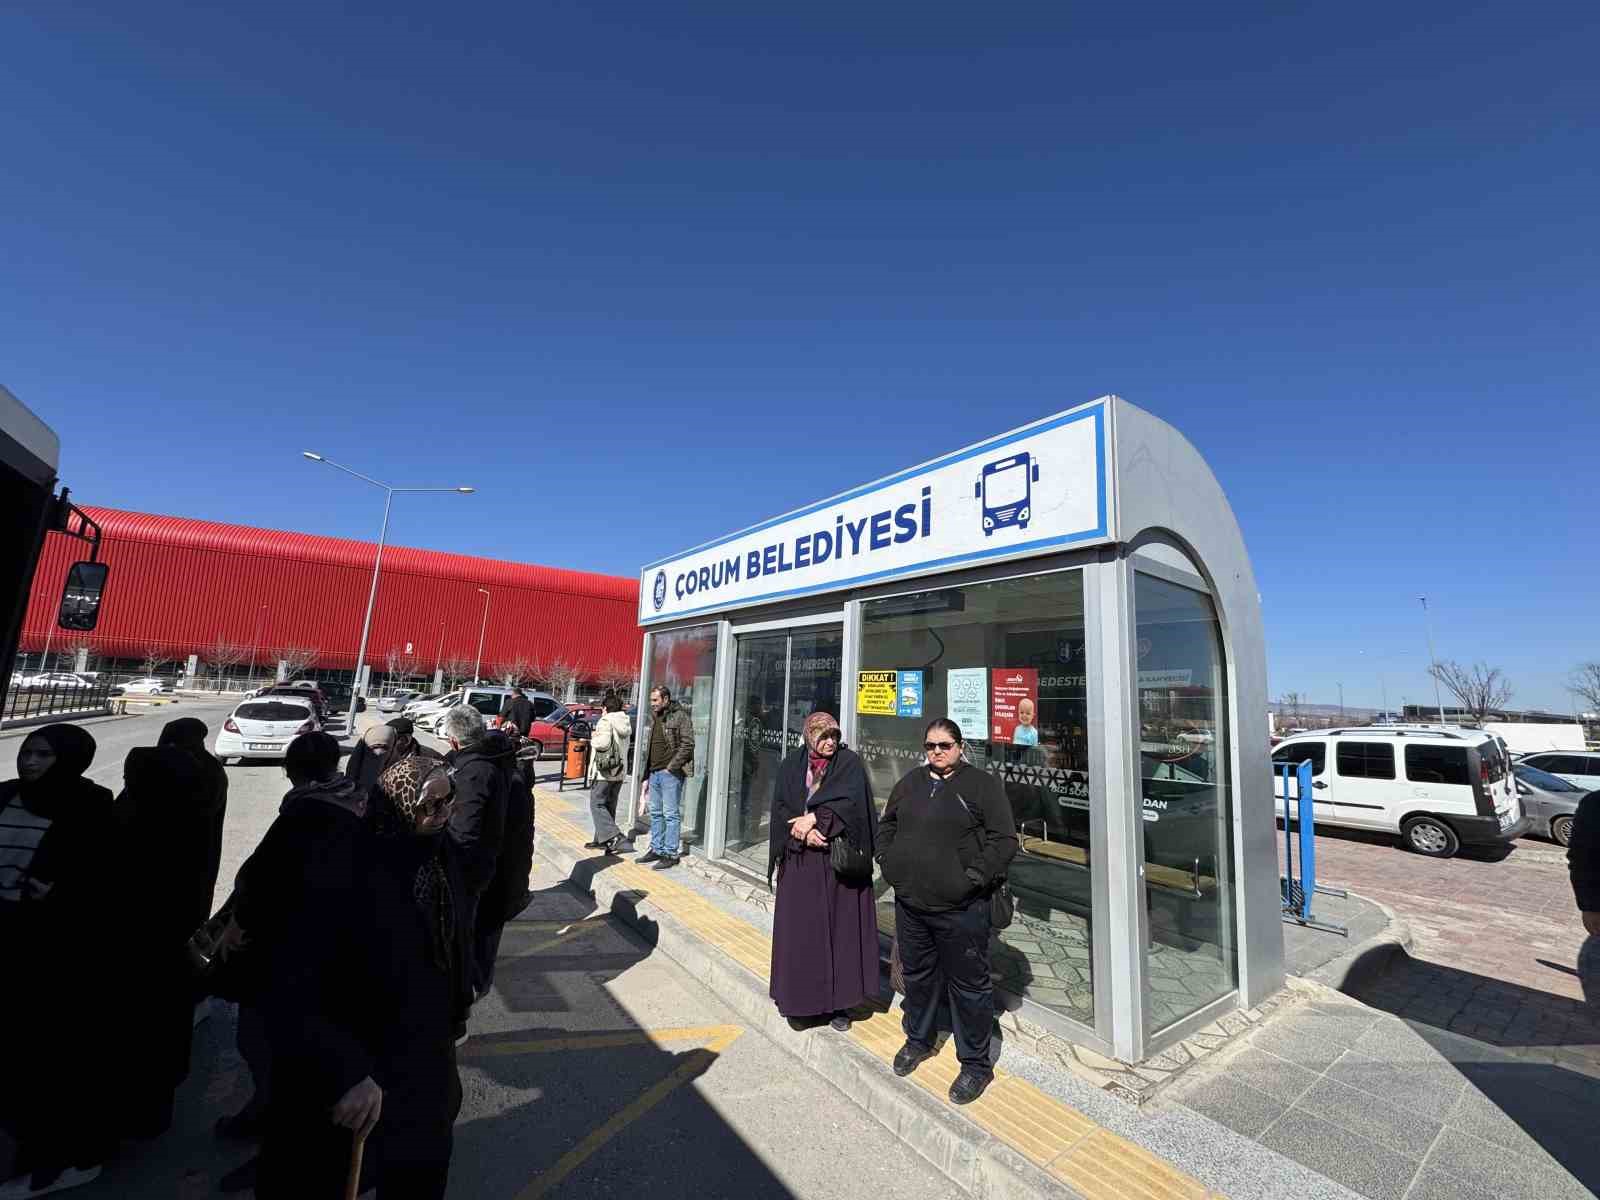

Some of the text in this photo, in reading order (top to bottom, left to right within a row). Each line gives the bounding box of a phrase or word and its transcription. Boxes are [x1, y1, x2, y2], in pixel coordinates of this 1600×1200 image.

[675, 485, 932, 600] ÇORUM BELEDİYESİ
[1036, 675, 1086, 687] EDESTE
[1143, 798, 1168, 810] DAN
